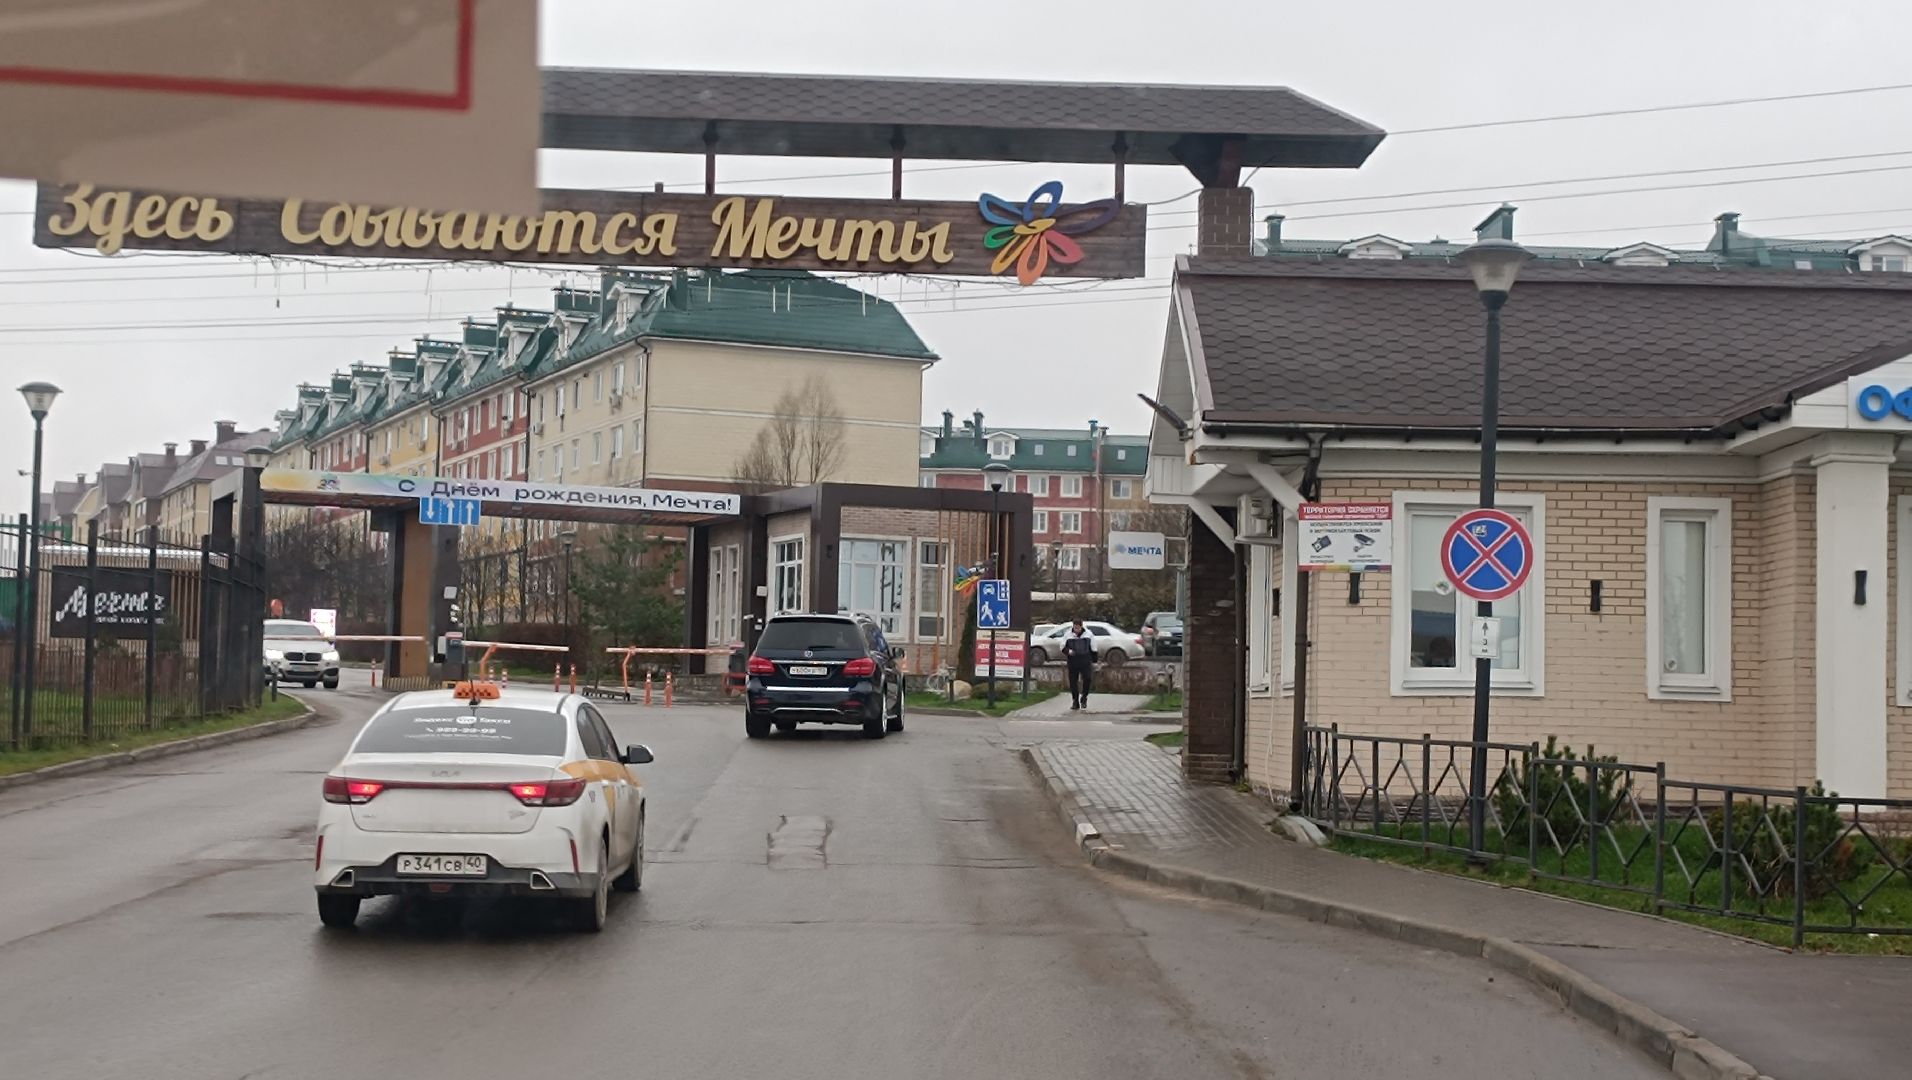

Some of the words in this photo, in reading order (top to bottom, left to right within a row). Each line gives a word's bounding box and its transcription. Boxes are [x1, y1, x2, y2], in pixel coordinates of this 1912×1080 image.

[48, 183, 234, 255] Здесь
[711, 196, 953, 265] Мечты
[398, 479, 416, 493] С
[430, 480, 500, 498] Днём
[515, 487, 646, 508] рождения,
[652, 494, 732, 511] Мечта!
[1127, 546, 1162, 556] МЕЧТА
[466, 856, 482, 869] 40
